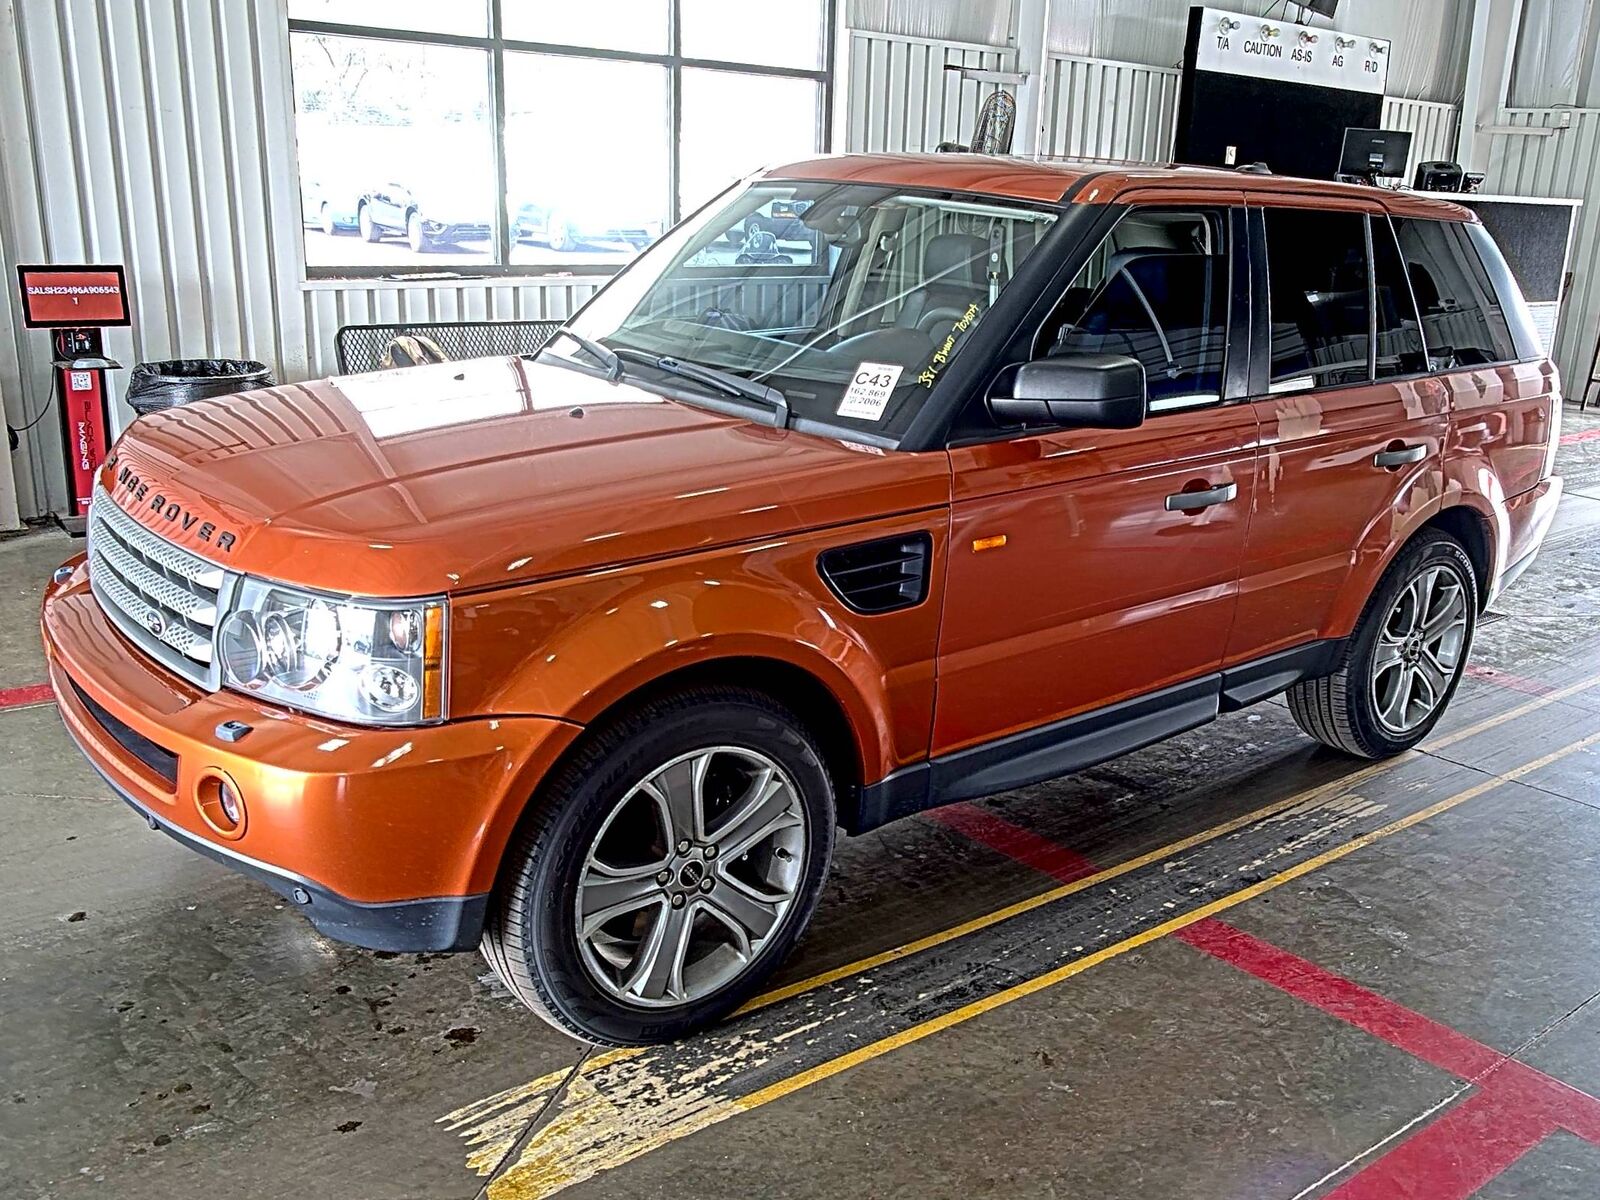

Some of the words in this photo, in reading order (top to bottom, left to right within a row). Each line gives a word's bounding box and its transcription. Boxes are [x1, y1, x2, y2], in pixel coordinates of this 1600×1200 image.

[1217, 36, 1230, 50] T/A
[1244, 41, 1282, 58] CAUTION
[1291, 49, 1313, 63] AS-IS
[1332, 55, 1344, 67] AG
[855, 372, 892, 388] C43
[918, 365, 938, 388] 381
[858, 397, 882, 407] 2006
[77, 422, 90, 471] IMAGING
[150, 494, 236, 553] ROVER
